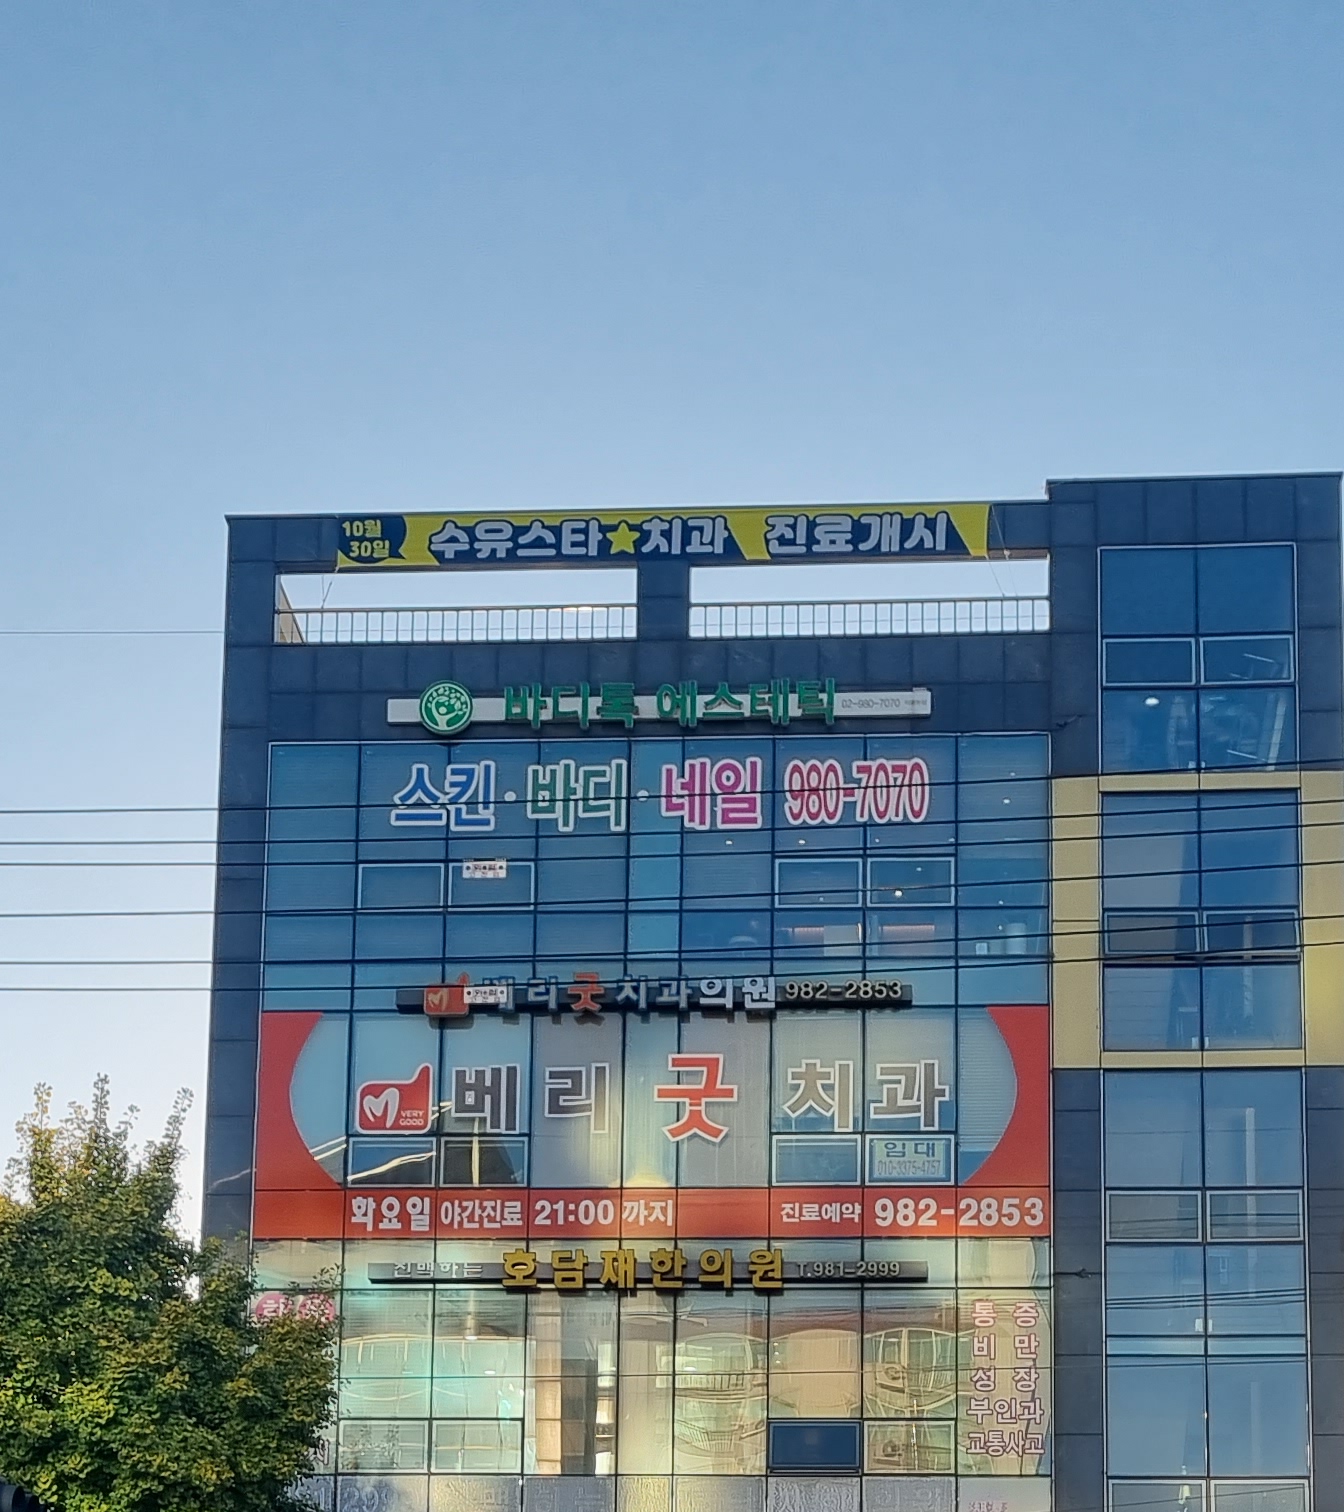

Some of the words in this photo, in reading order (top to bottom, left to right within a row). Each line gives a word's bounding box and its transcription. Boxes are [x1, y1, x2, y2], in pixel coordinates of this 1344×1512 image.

[342, 520, 382, 536] 10월
[765, 513, 948, 554] 진료개시
[349, 540, 390, 558] 30일
[656, 678, 835, 728] 에스테틱
[661, 756, 763, 830] 네일
[783, 758, 930, 826] 980-7070
[784, 978, 903, 999] 982-2853
[782, 1058, 950, 1133] 치과
[399, 1118, 425, 1126] GOOD
[401, 1109, 425, 1117] VERY
[884, 1140, 939, 1158] 임대
[351, 1195, 431, 1232] 화요일
[440, 1198, 524, 1227] 야간진료
[533, 1197, 615, 1227] 21:00
[622, 1198, 674, 1228] 까지
[779, 1202, 862, 1225] 진료예약
[874, 1196, 1045, 1228] 982-2853
[502, 1249, 784, 1290] 호담재한의원
[797, 1261, 900, 1278] T.981-2999
[971, 1301, 1040, 1328] 통증
[973, 1333, 1040, 1360] 비만
[971, 1365, 1040, 1392] 성장
[966, 1397, 1045, 1425] 부인과
[966, 1429, 1045, 1457] 교통사고
